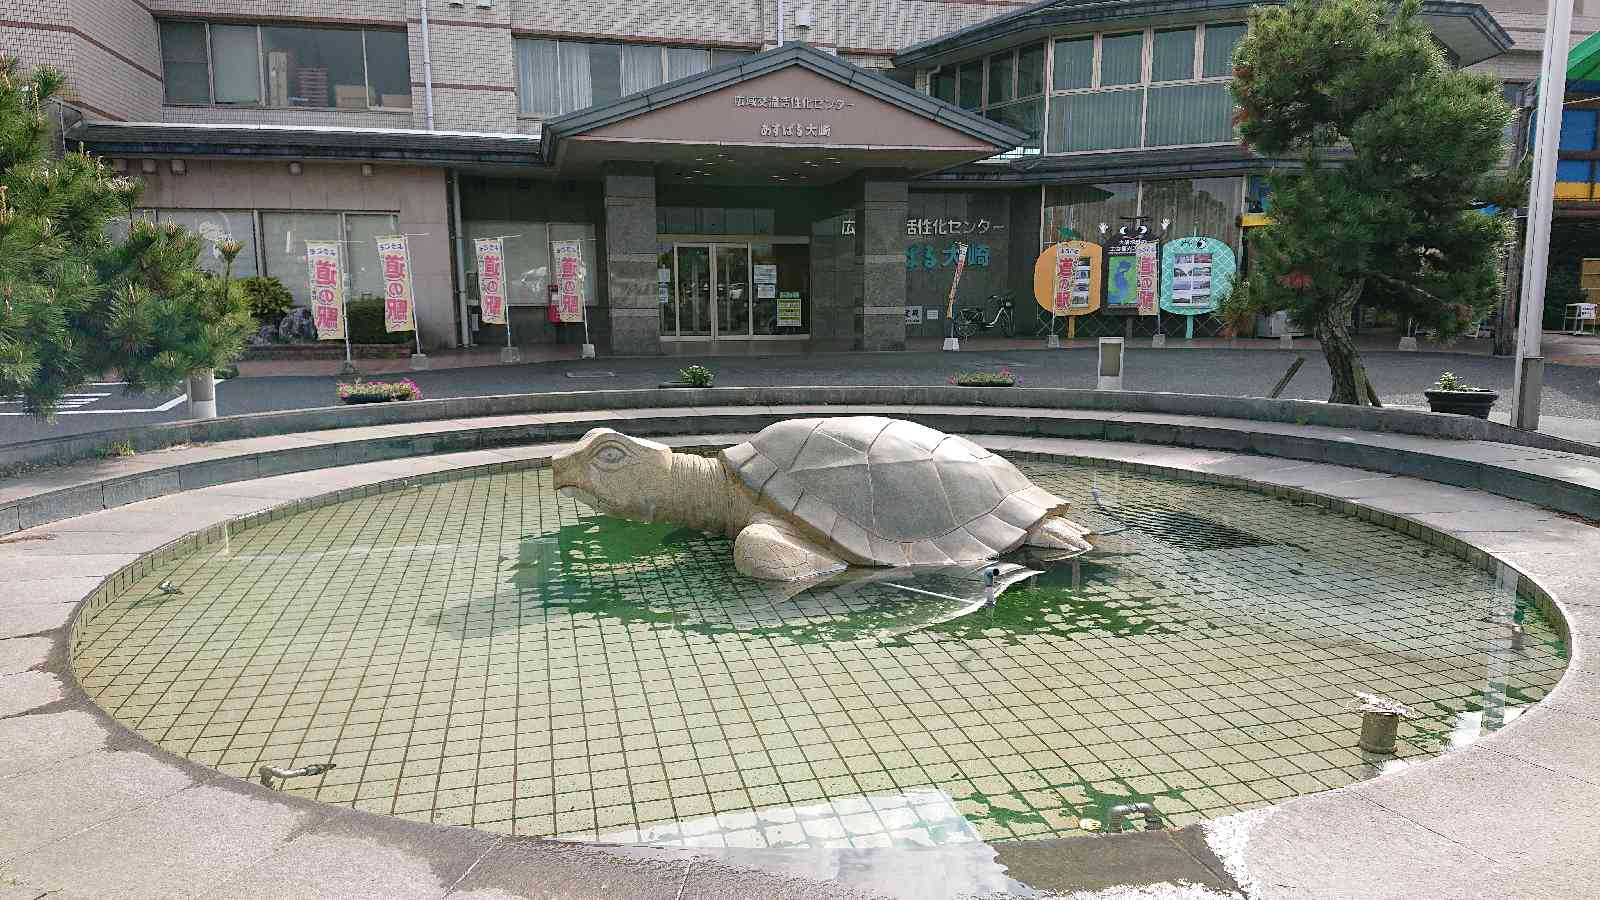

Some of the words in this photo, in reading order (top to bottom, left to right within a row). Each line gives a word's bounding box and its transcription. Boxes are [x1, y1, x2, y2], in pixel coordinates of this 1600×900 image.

[735, 96, 855, 110] 広域交流活性化センター
[760, 123, 832, 137] あすばる大崎
